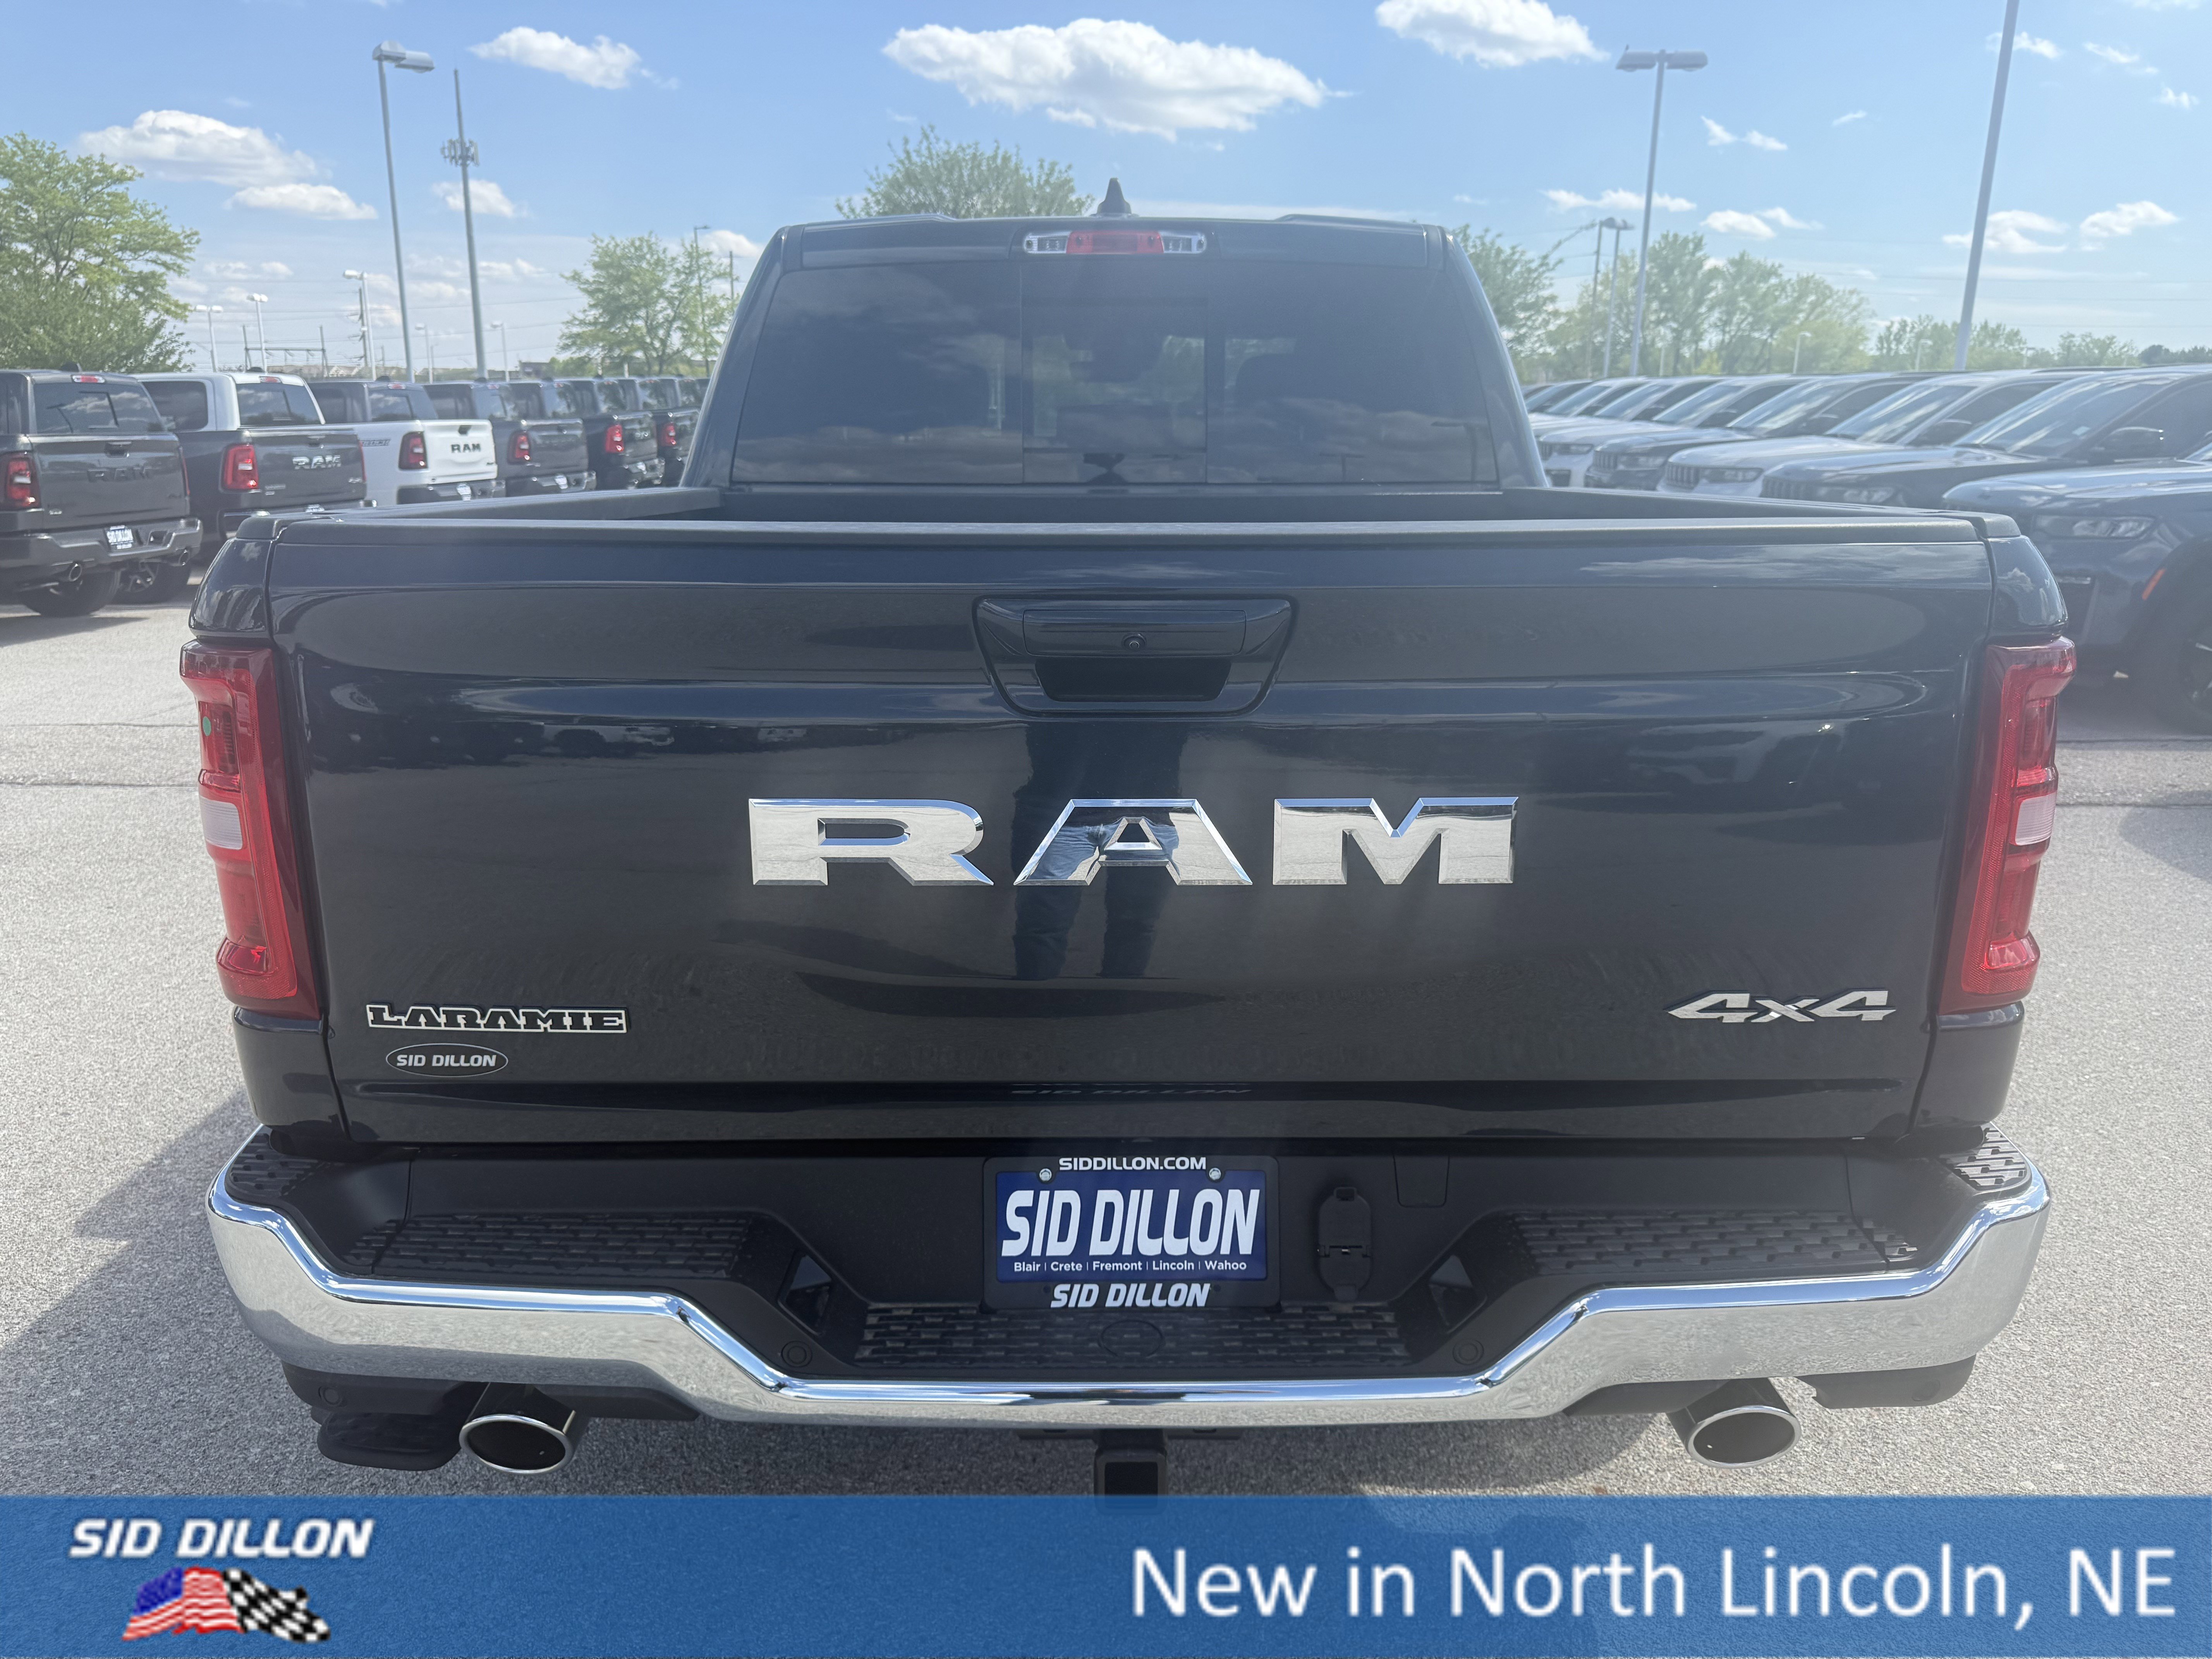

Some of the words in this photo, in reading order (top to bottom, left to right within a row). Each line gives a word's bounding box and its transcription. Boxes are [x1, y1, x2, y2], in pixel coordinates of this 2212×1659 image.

[450, 444, 481, 453] RAM
[293, 455, 341, 470] RAM
[749, 797, 1518, 886] RAM
[1668, 991, 1896, 1022] 4x4
[366, 1005, 627, 1033] LARAMIE
[397, 1054, 426, 1066] SID
[432, 1054, 496, 1066] DILLON
[1059, 1157, 1206, 1170] SIDDILLON.COM
[1002, 1190, 1081, 1256] SID
[1089, 1189, 1260, 1256] DILLON
[1014, 1261, 1041, 1272] Blair
[1051, 1261, 1082, 1271] Crete
[1093, 1261, 1142, 1271] Fremont
[1152, 1260, 1194, 1271] Lincoln
[1204, 1260, 1247, 1271] Wahoo
[1051, 1284, 1099, 1308] SID
[1105, 1283, 1211, 1307] DILLON
